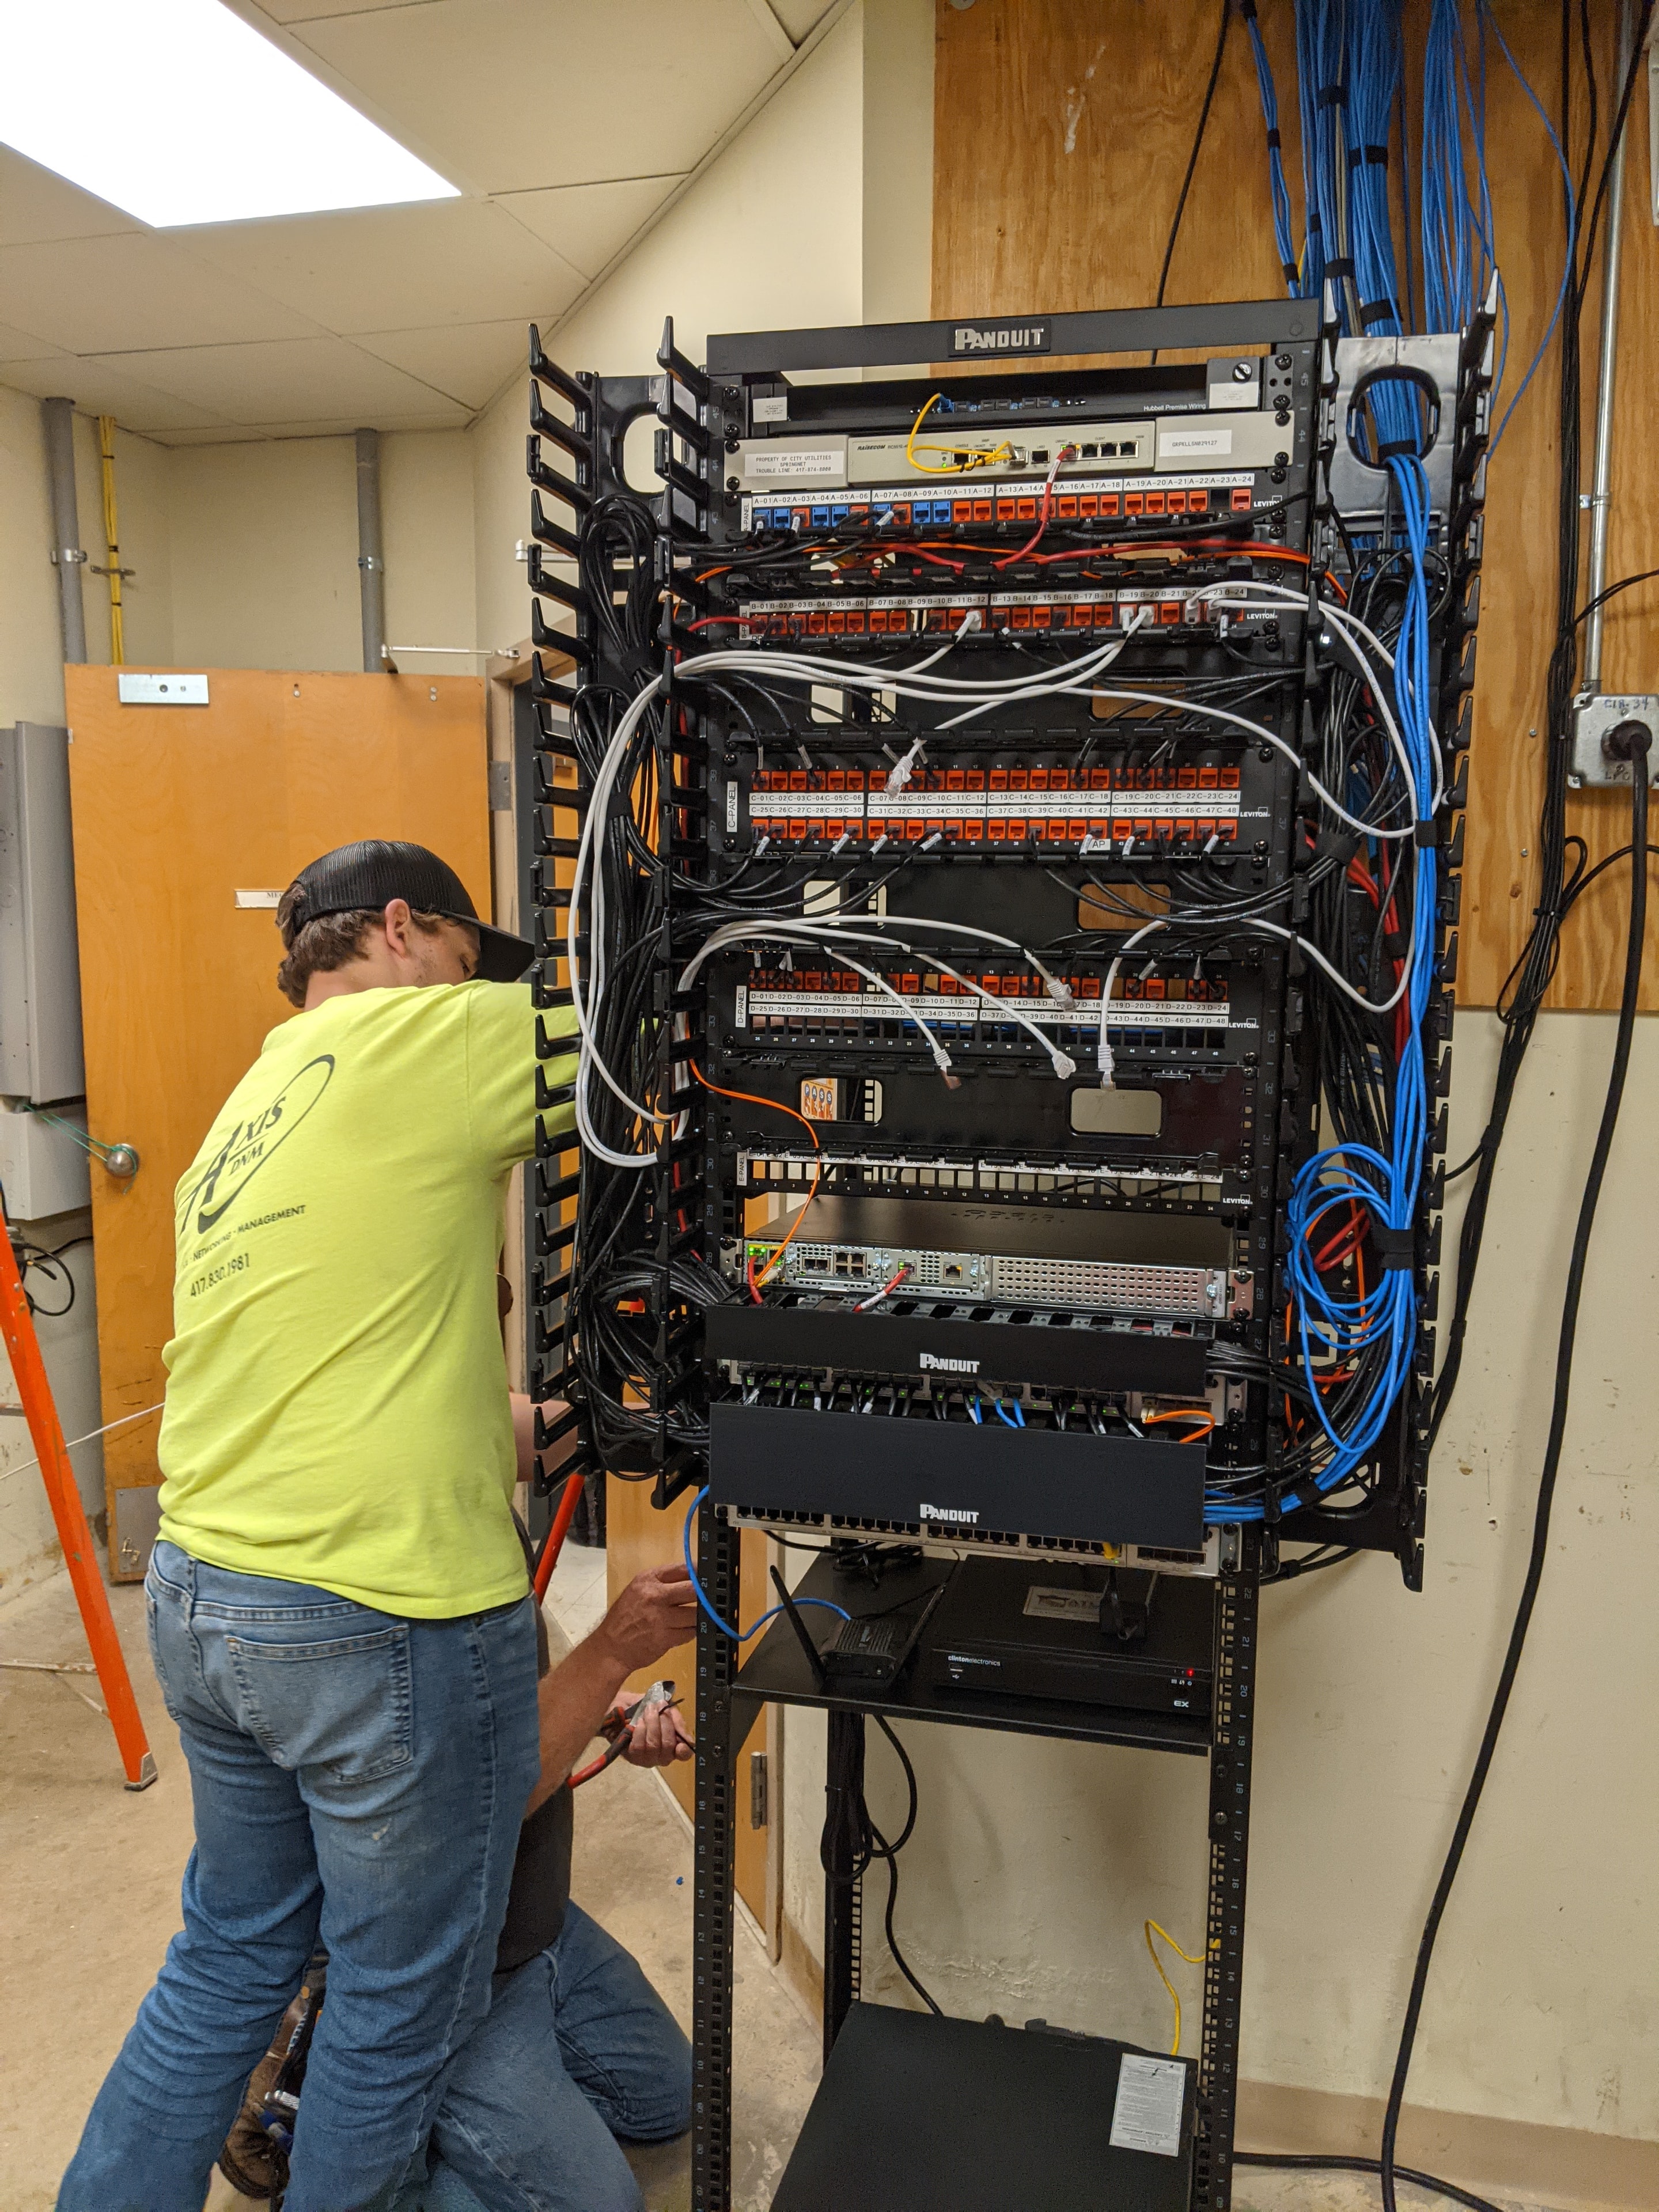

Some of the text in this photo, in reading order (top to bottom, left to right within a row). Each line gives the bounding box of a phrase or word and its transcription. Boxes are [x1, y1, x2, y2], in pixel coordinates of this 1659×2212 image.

[955, 328, 1044, 350] PANDUIT
[728, 786, 736, 828] C-PANEL
[1092, 840, 1105, 849] AP
[180, 1096, 286, 1236] AXIS
[228, 1142, 264, 1176] DNM
[237, 1205, 306, 1234] MANAGEMENT
[190, 1253, 250, 1298] 417.830.1981
[919, 1353, 980, 1374] PANDUIT
[919, 1503, 980, 1524] PANDUIT
[948, 1655, 1001, 1667] clintonelectronics
[1173, 1700, 1189, 1709] EX
